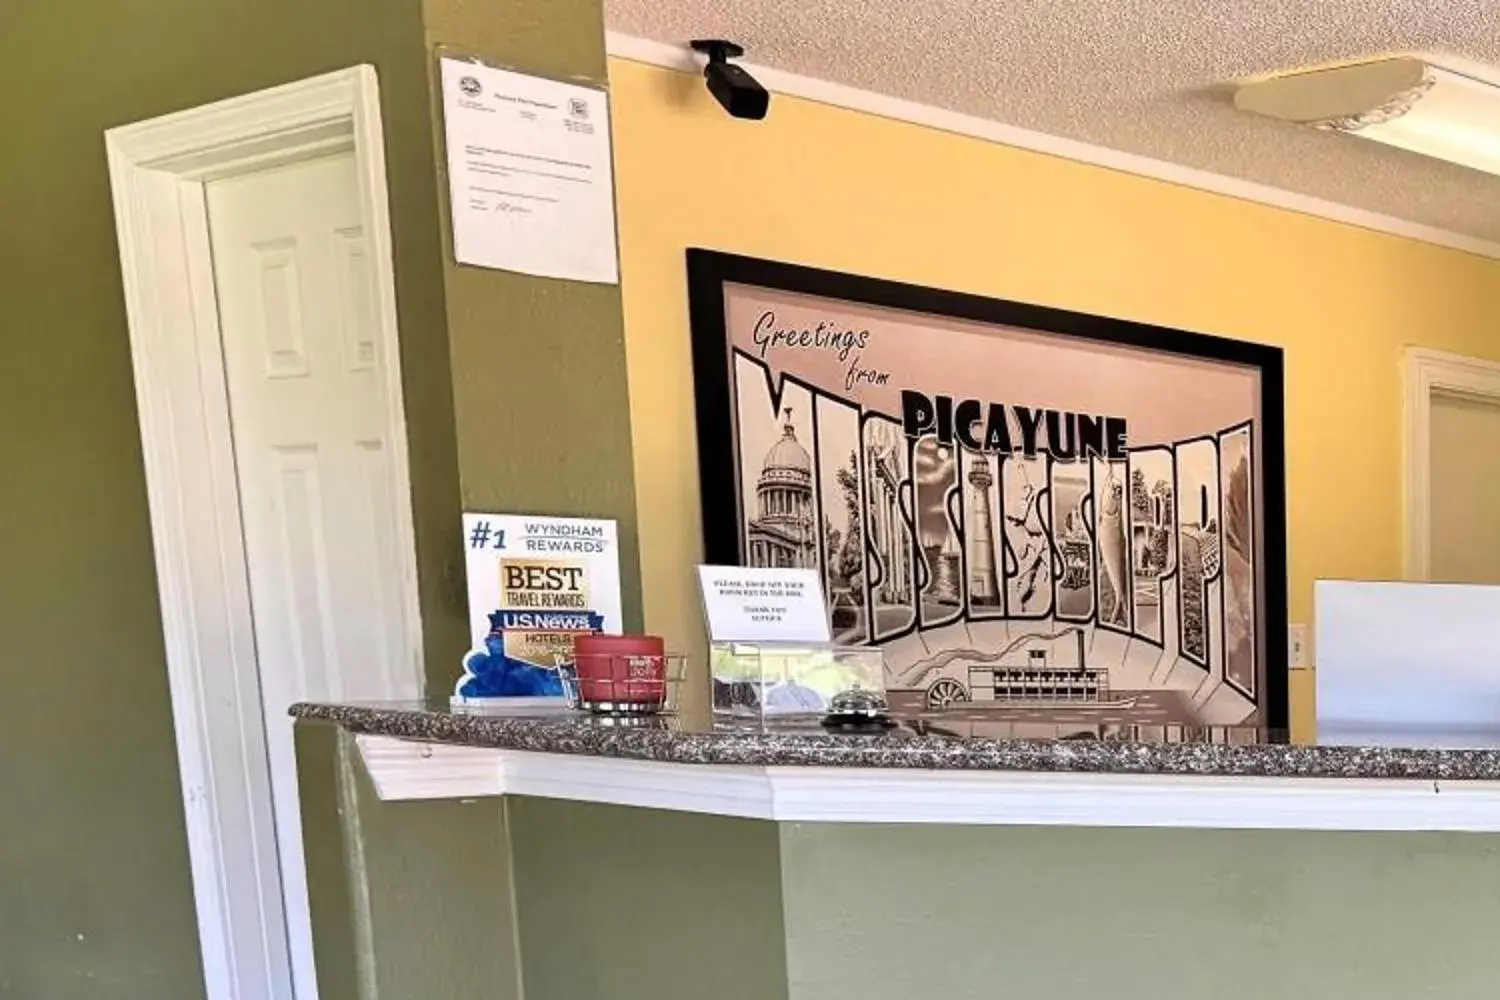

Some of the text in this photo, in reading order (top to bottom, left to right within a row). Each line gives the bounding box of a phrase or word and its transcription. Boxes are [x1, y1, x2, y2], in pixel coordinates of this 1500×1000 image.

[753, 311, 870, 362] Greetings
[845, 356, 890, 390] from
[901, 389, 1130, 463] PICAYUNE
[470, 520, 604, 550] #1 WYNDHAM
[733, 346, 1257, 706] MISSISSIPPI
[526, 539, 605, 553] REWARDS
[504, 566, 583, 591] BEST
[507, 592, 585, 608] TRAVEL REWARDS
[525, 633, 571, 643] HOTELS
